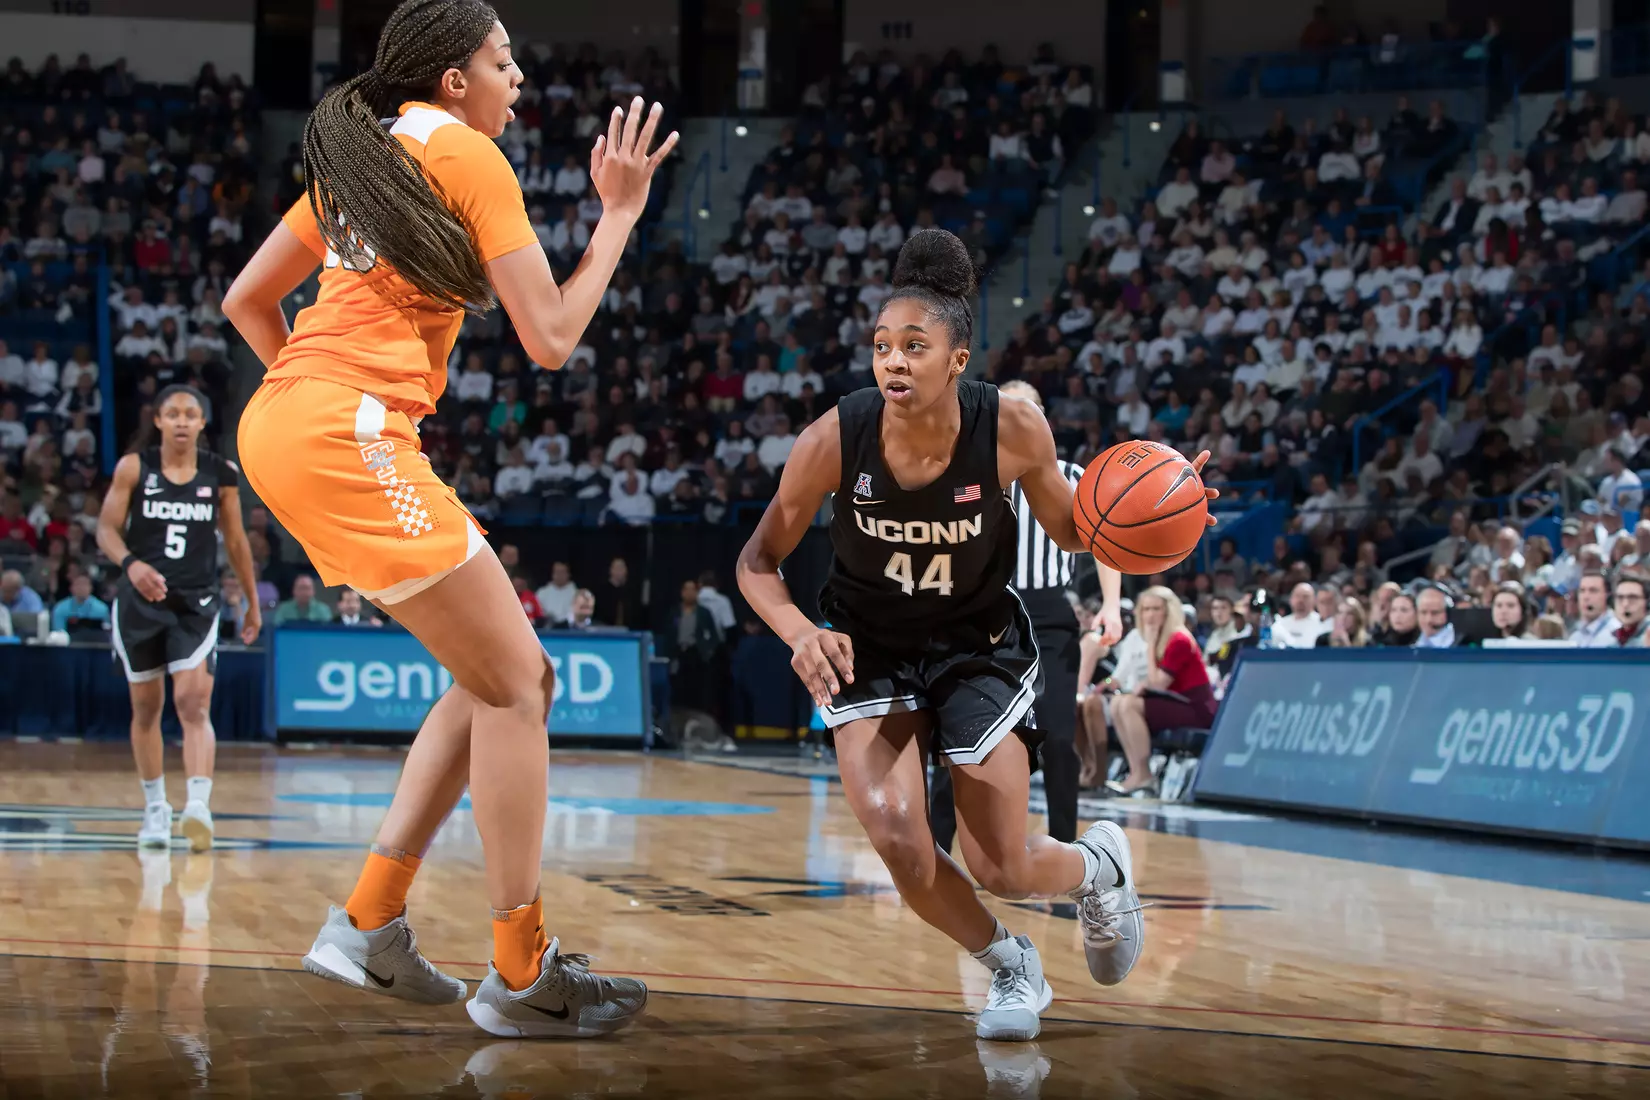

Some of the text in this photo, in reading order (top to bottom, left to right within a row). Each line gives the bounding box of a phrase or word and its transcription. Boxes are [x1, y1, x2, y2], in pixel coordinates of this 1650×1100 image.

[1120, 443, 1166, 470] LITE
[142, 500, 213, 521] UCONN
[853, 509, 982, 545] UCONN
[164, 524, 188, 559] 5
[884, 551, 954, 596] 44
[1223, 681, 1393, 767] genius3D
[1409, 686, 1635, 785] genius3D
